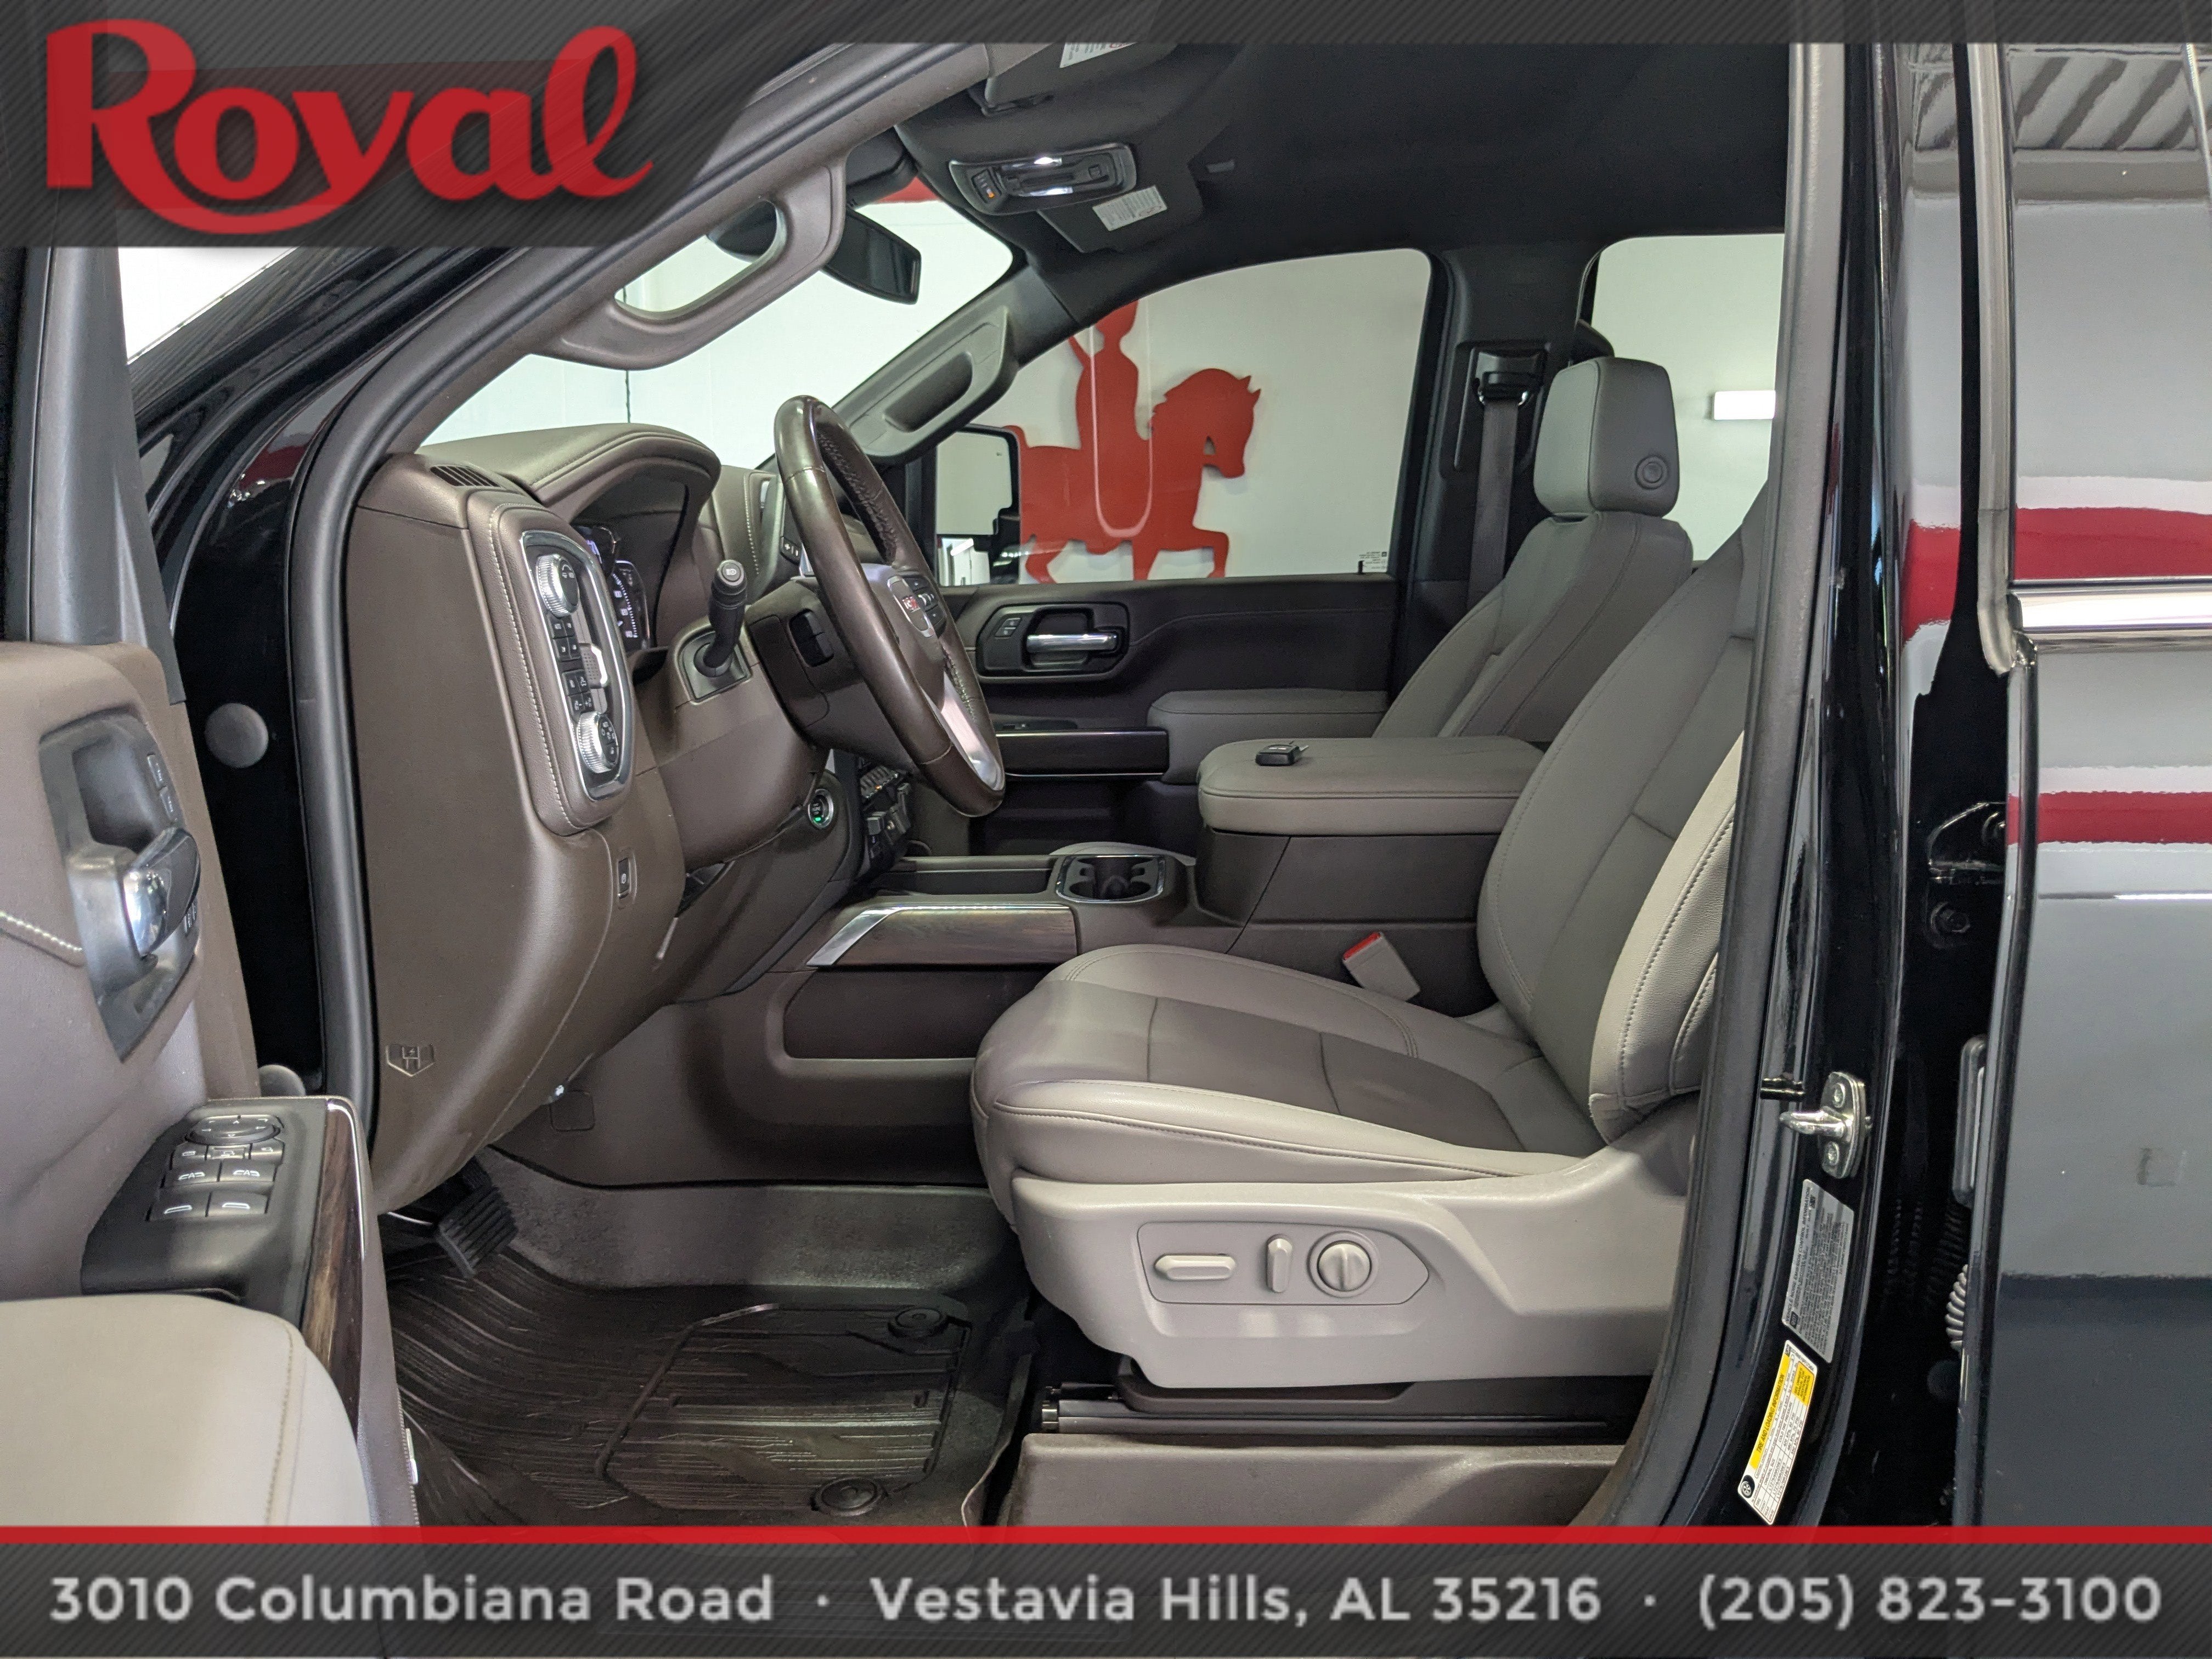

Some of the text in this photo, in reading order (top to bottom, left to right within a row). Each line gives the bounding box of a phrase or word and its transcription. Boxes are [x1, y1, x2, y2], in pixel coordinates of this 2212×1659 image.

[1764, 1406, 1774, 1431] LOADING
[1771, 1373, 1784, 1408] INFORMATION
[1784, 1401, 1792, 1423] PRESSURE
[1764, 1467, 1772, 1486] ORIGINAL
